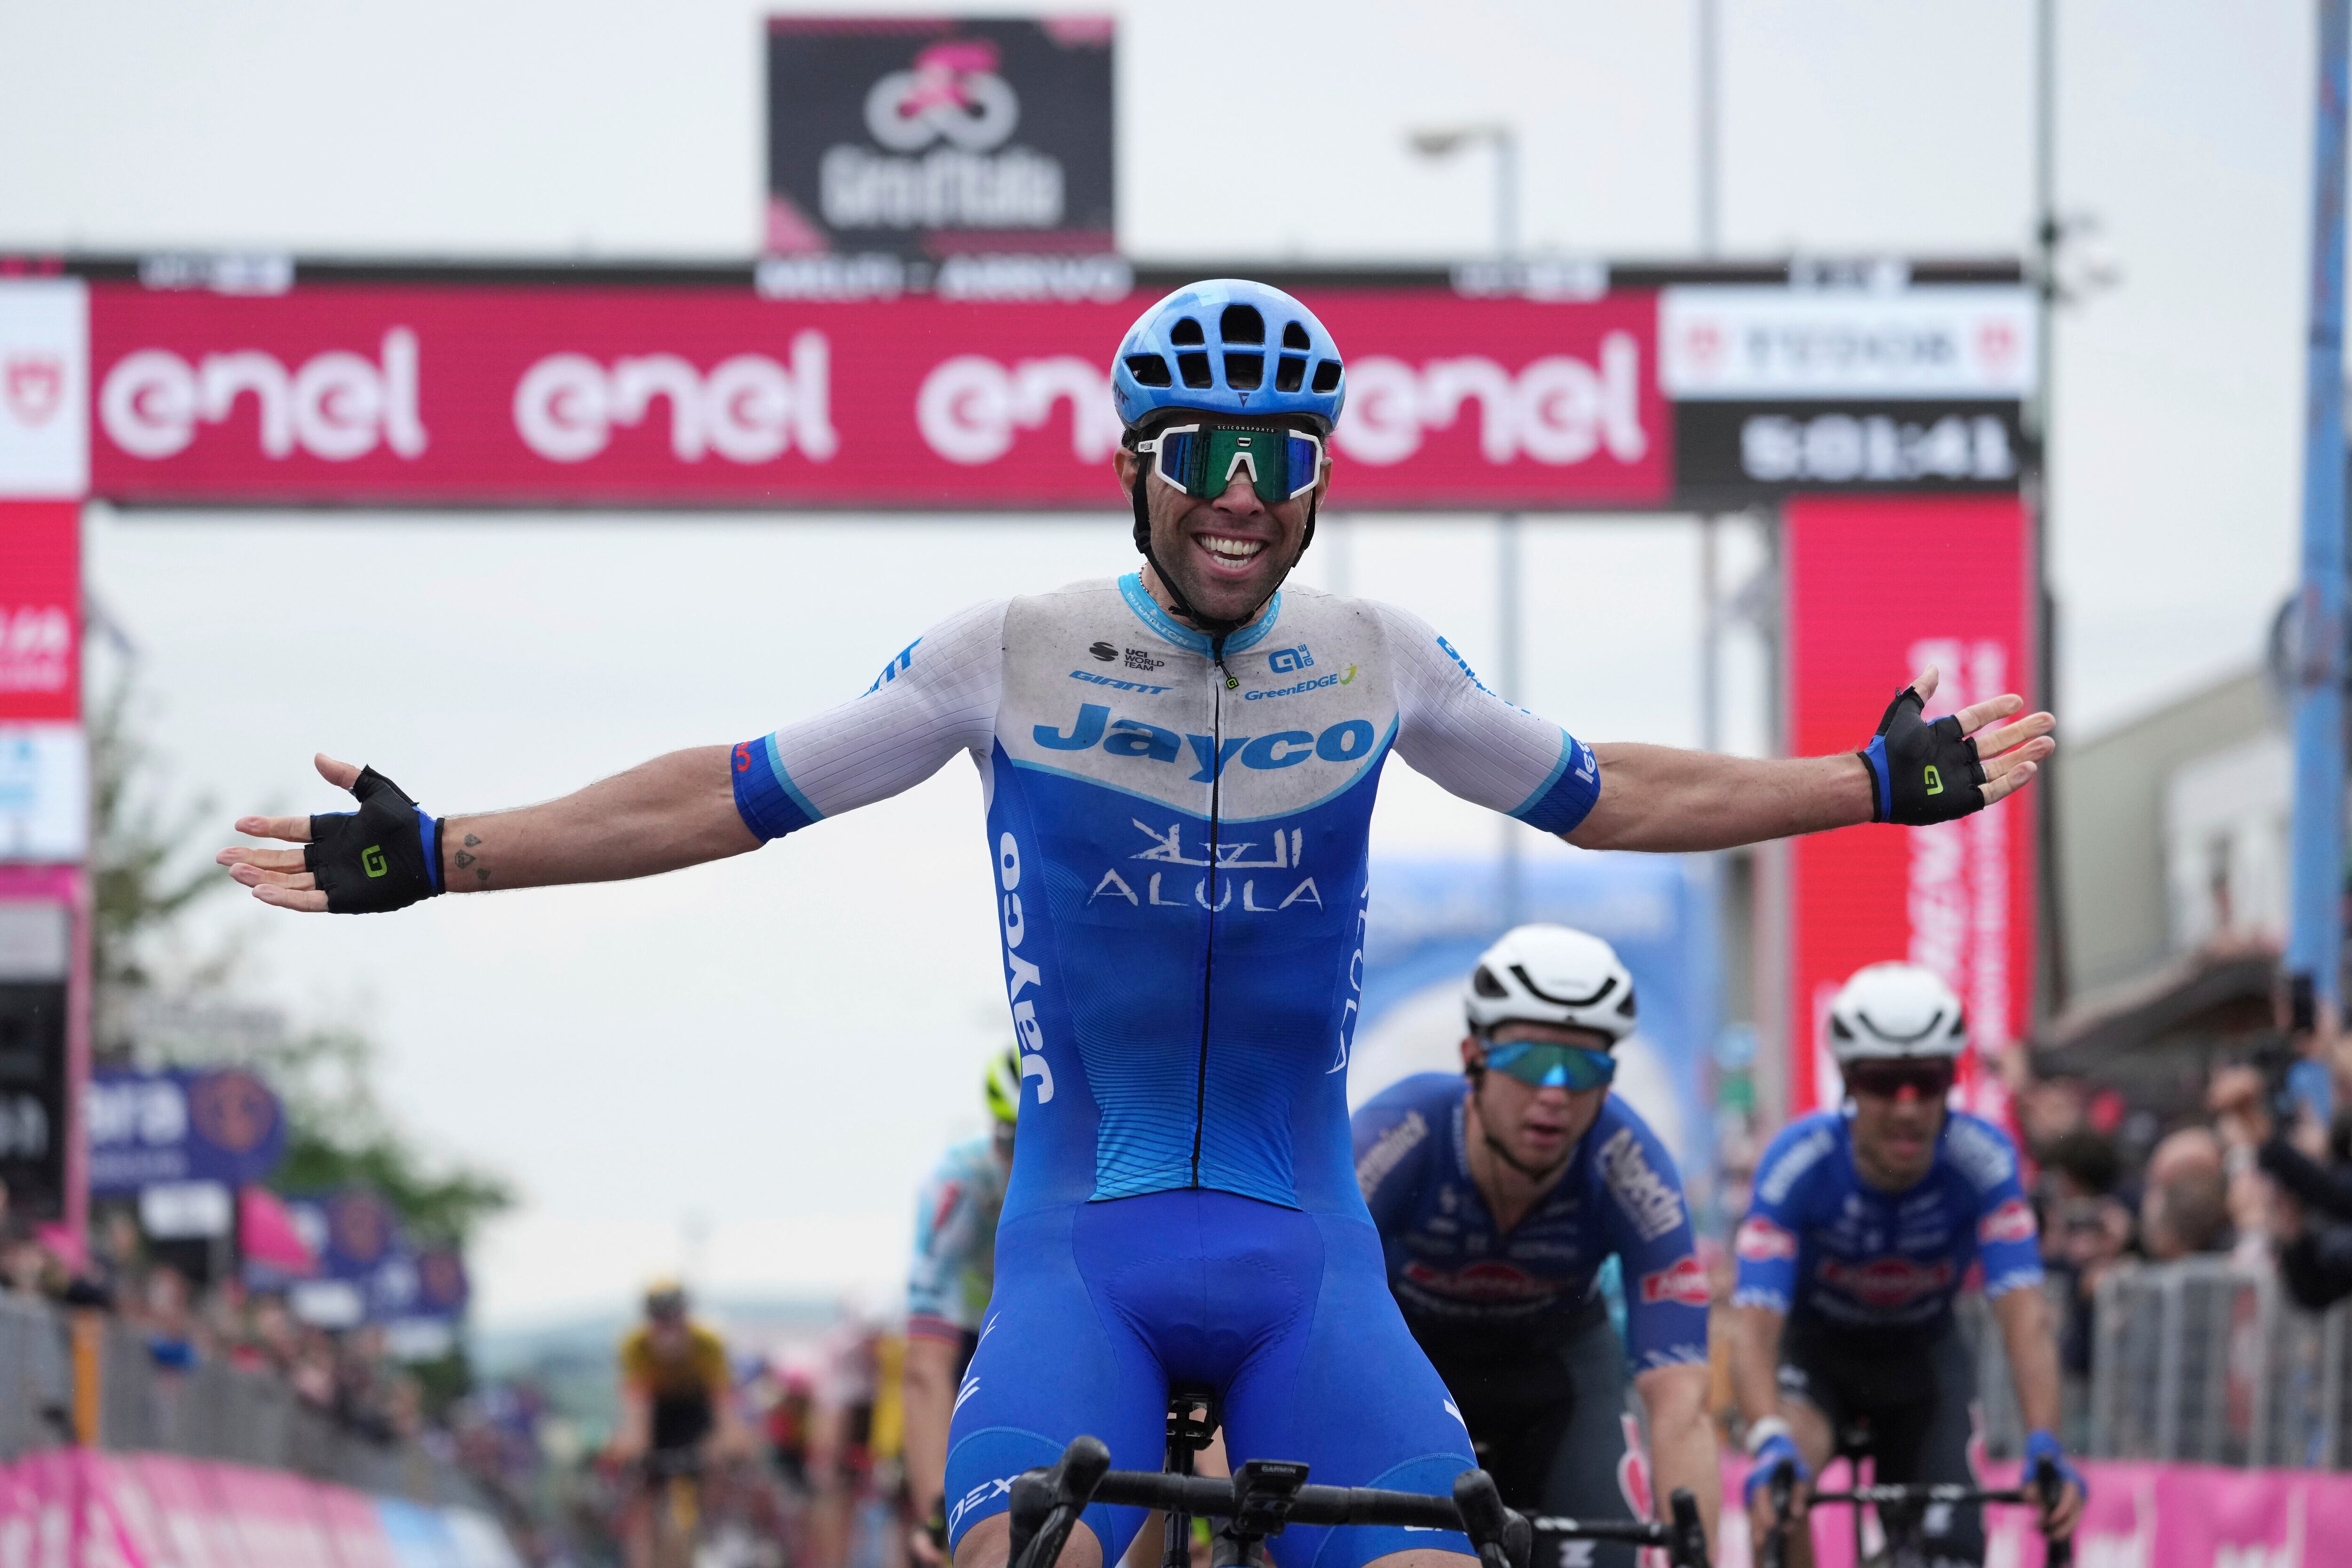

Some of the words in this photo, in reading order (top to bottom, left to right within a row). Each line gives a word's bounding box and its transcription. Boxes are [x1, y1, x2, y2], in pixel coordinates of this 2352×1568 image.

[100, 326, 427, 460] enel
[514, 329, 839, 464] enel
[916, 353, 1123, 464] en
[1332, 329, 1646, 465] enel
[1124, 661, 1153, 671] TEAM
[1125, 654, 1165, 667] WORLD
[1126, 648, 1147, 658] UCI
[1069, 670, 1174, 694] GIANT
[1245, 673, 1338, 700] GreenEDGE
[1033, 703, 1375, 783] Jayco
[1087, 868, 1324, 913] ALULA
[1000, 832, 1055, 1105] Jayco
[1261, 1465, 1296, 1474] GARMIN
